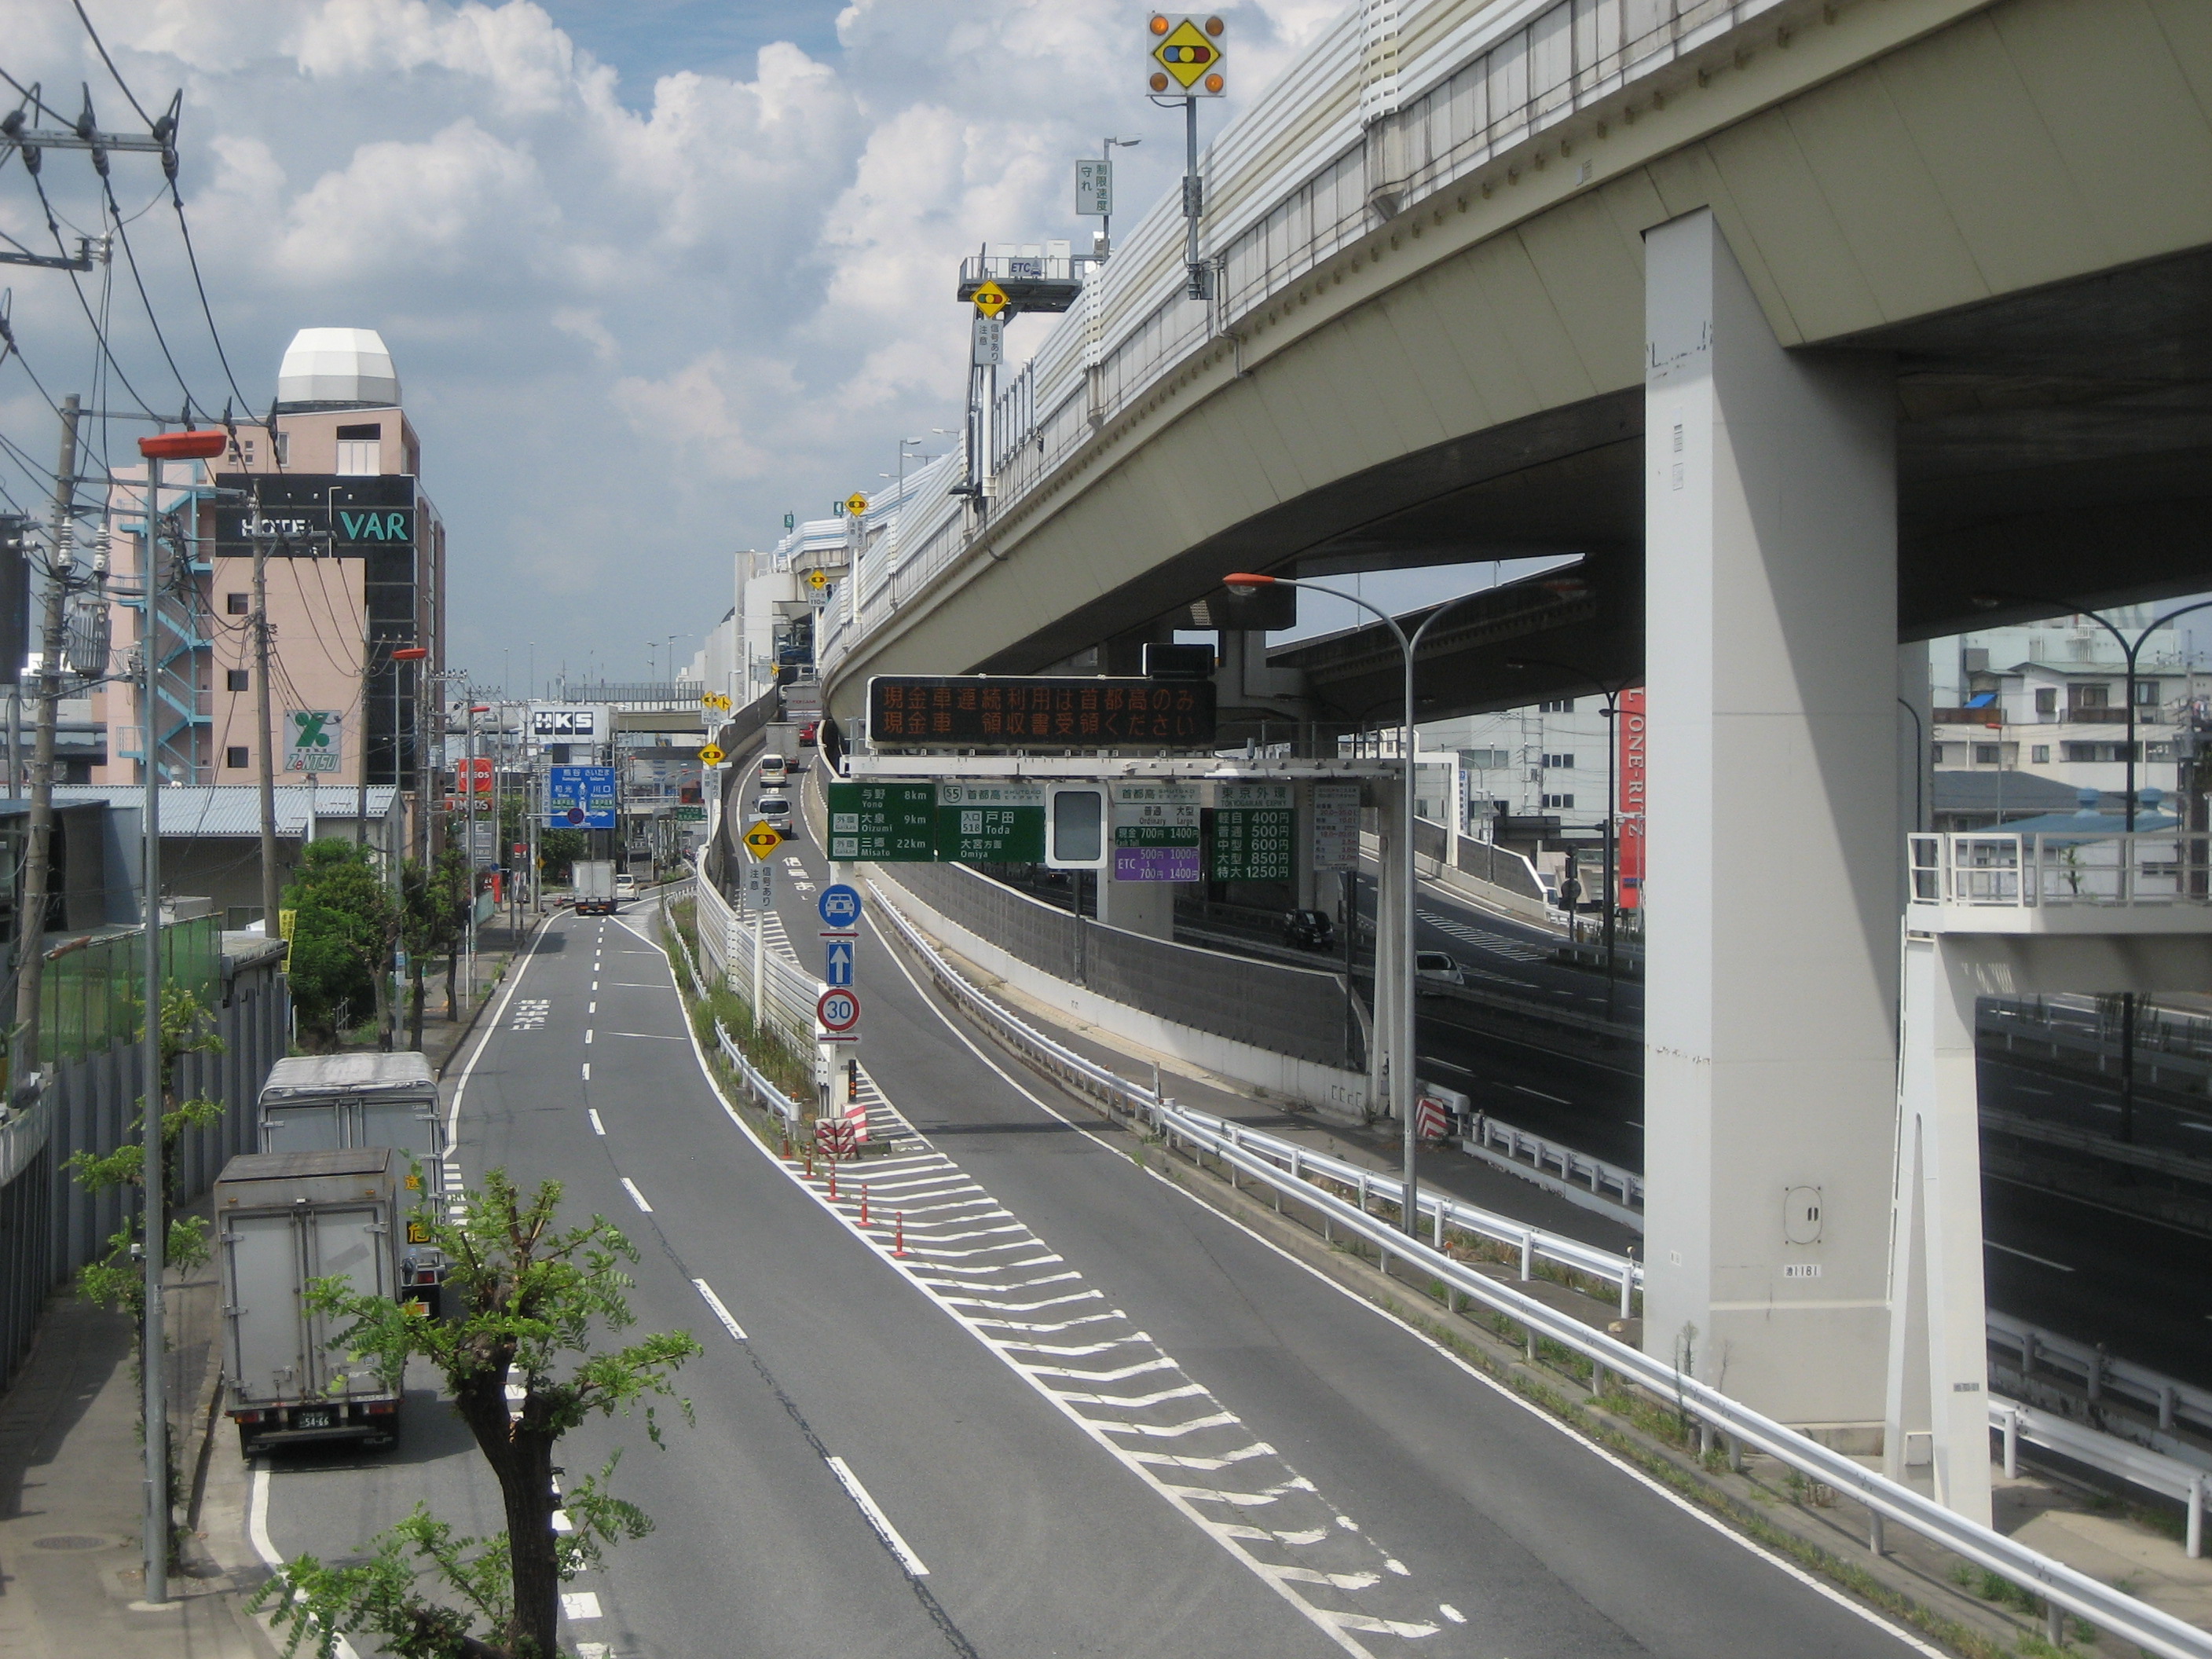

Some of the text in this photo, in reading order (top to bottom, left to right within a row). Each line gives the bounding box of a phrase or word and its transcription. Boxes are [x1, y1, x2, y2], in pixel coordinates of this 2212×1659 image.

[1081, 166, 1093, 192] 守れ
[1096, 164, 1108, 211] 制限速度
[1011, 262, 1031, 273] ETC
[339, 511, 408, 540] VAR
[883, 686, 1195, 710] 現金車連続利用は首都高のみ
[535, 712, 592, 729] HKS
[883, 711, 953, 734] 現金車
[593, 785, 611, 793] 川口
[862, 788, 927, 800] 与野 8km
[946, 788, 1001, 800] S5 首都高
[1221, 786, 1287, 800] 東京外環
[1176, 806, 1194, 816] 大型
[862, 813, 885, 824] 大泉
[904, 815, 926, 824] 9km
[962, 811, 1014, 824] 入口 戸田
[1251, 811, 1289, 824] 400円
[962, 823, 1010, 834] 518 Toda
[1141, 828, 1164, 838] 700円
[1170, 828, 1199, 838] 1400円
[1251, 826, 1289, 837] 500円
[896, 838, 926, 848] 22km
[961, 838, 1002, 849] 大宮方面
[1218, 838, 1289, 851] 中型 600円
[961, 850, 988, 859] Omiya
[1141, 848, 1199, 859] 500円 1000円
[1218, 852, 1288, 865] 大型 850円
[1118, 859, 1136, 870] ETC
[1140, 868, 1199, 879] 700円 1400円
[1217, 866, 1288, 878] 特大 1250円
[749, 869, 760, 891] 注意
[762, 866, 772, 906] 信号あり
[827, 1001, 851, 1019] 30
